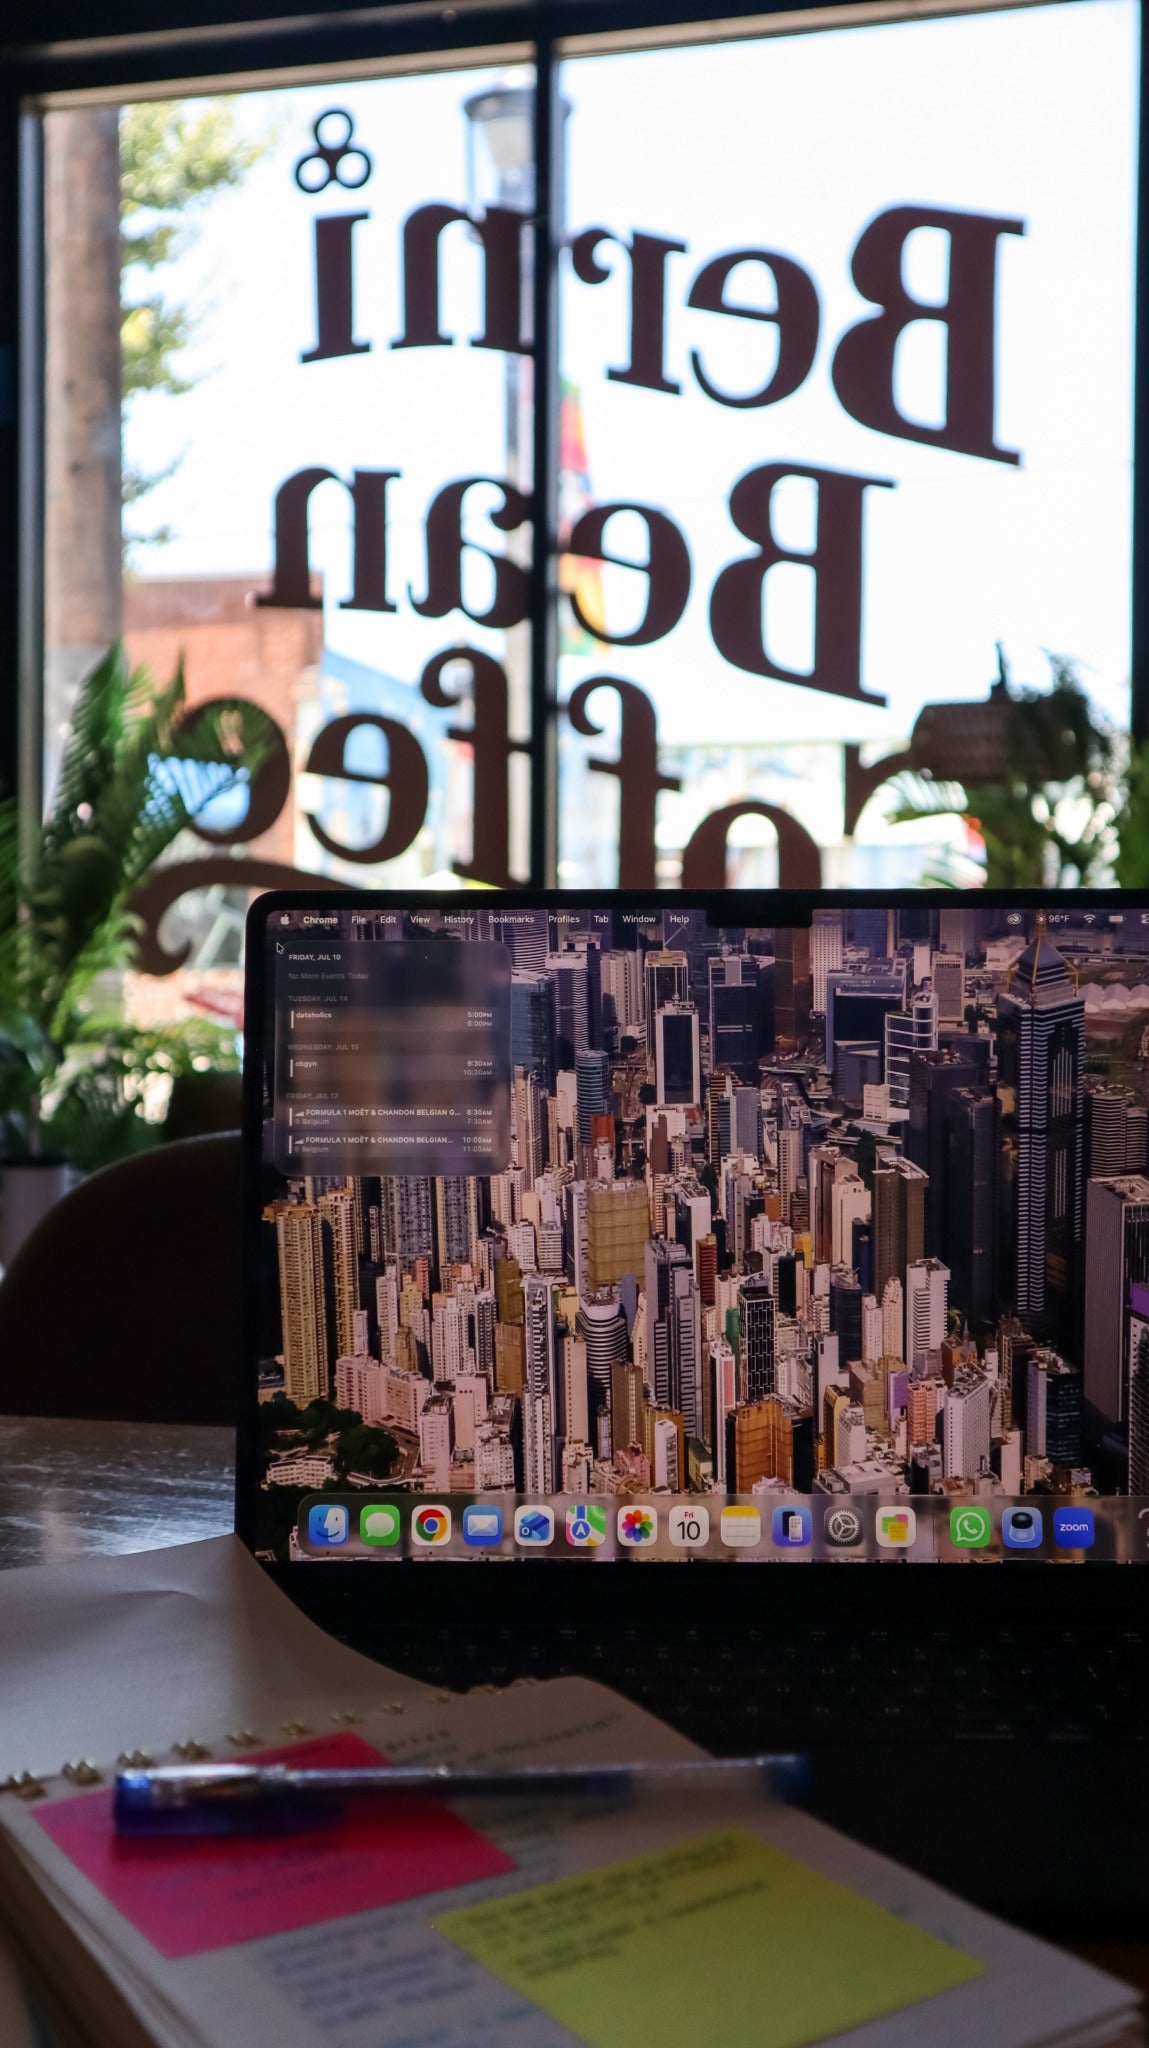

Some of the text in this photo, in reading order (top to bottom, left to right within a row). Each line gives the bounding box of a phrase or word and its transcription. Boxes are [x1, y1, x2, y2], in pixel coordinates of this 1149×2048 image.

[303, 915, 690, 926] Chrome File Edit View History Bookmarks Profiles Tab Window Help
[289, 954, 316, 962] FRIDAY,
[288, 972, 369, 982] No More Events Today
[295, 1011, 332, 1019] dataholics
[295, 1060, 318, 1069] obgyn
[315, 1092, 328, 1100] JUL
[330, 1092, 339, 1100] 17
[302, 1118, 330, 1126] Belgium
[305, 1136, 341, 1144] FORMULA
[377, 1136, 415, 1144] CHANDON
[301, 1146, 329, 1154] Belgium
[684, 1511, 694, 1519] Fri
[677, 1521, 700, 1540] 10
[1059, 1523, 1089, 1532] zoom
